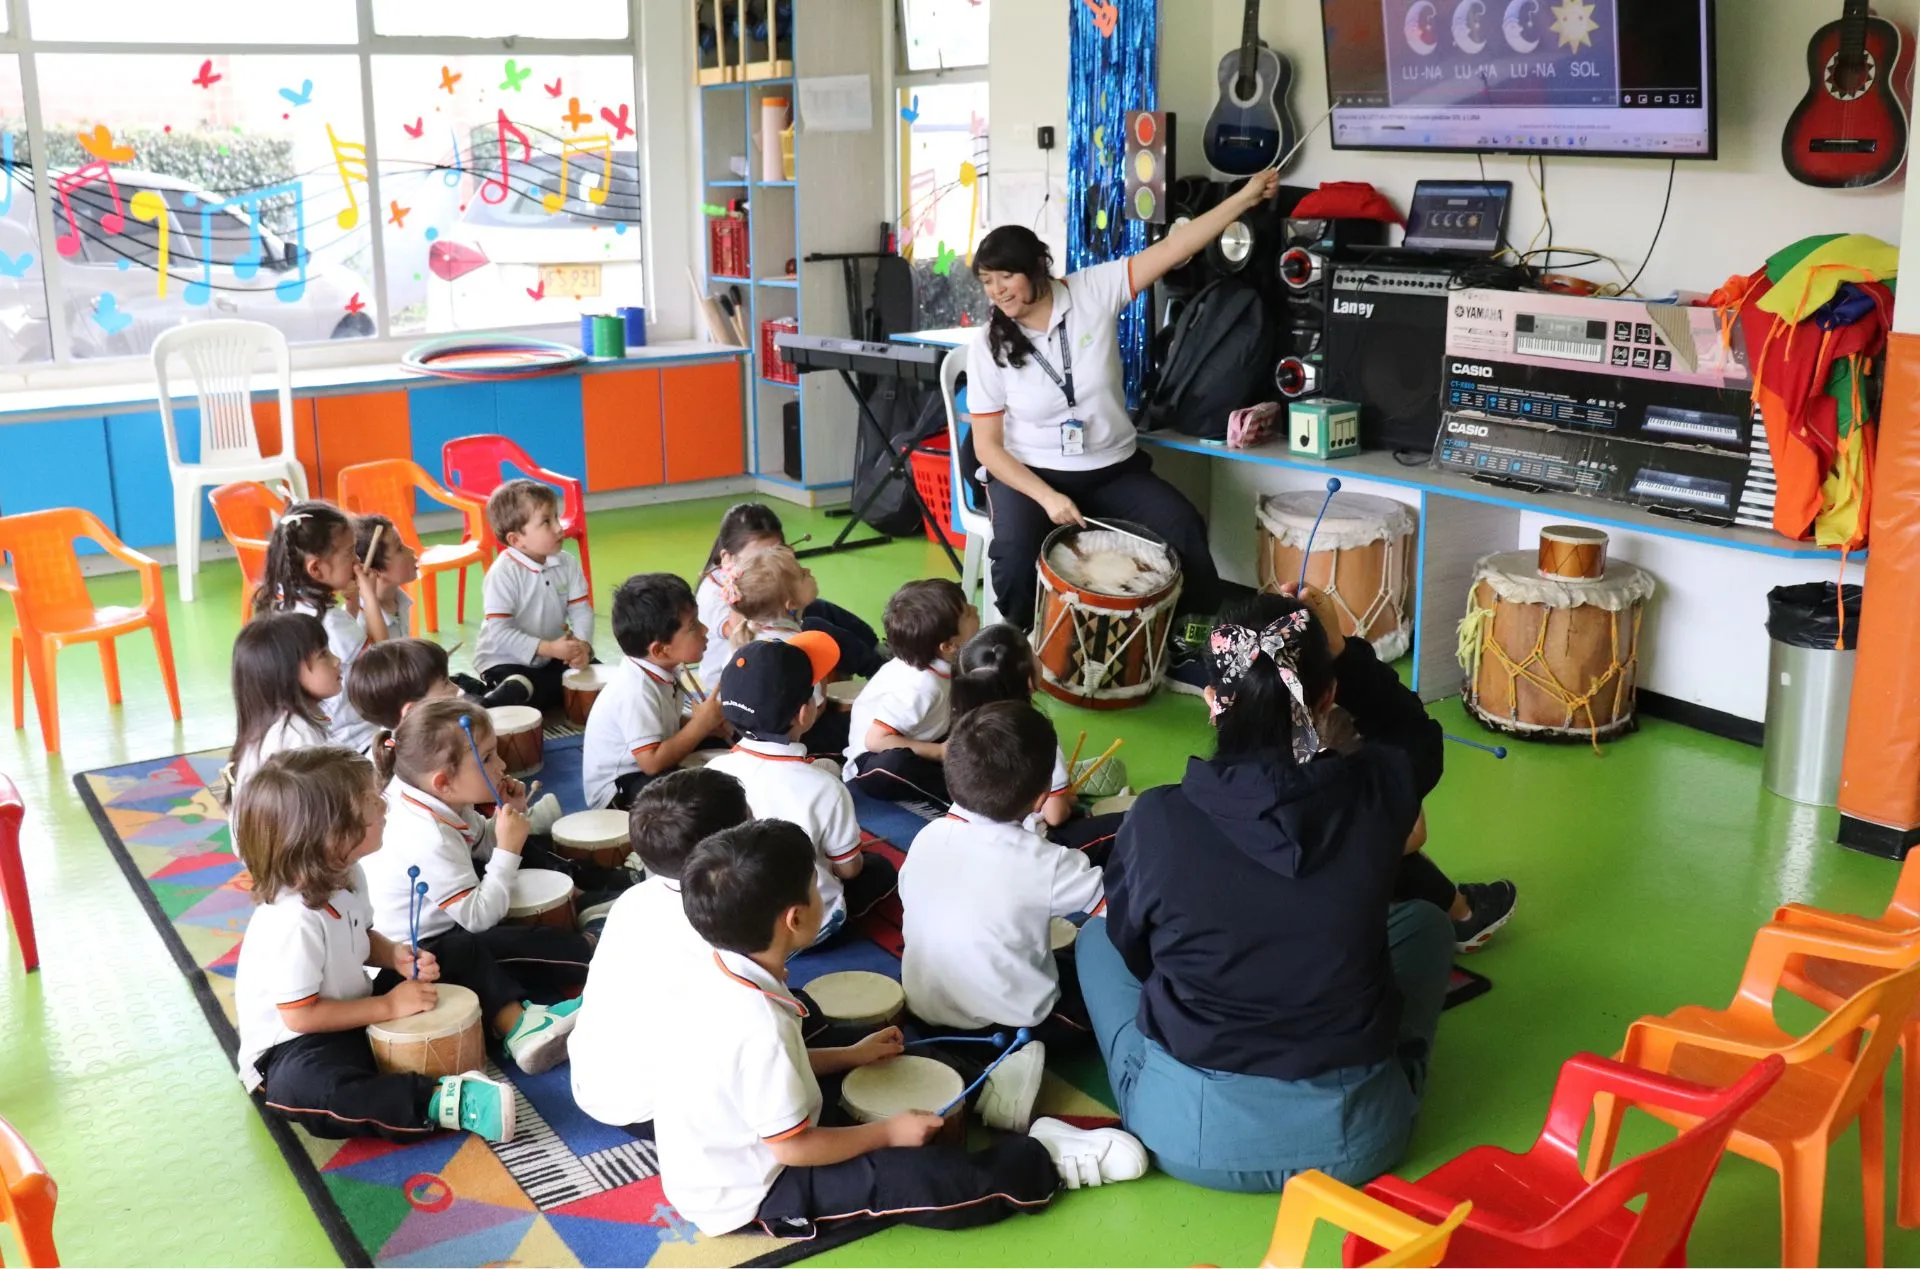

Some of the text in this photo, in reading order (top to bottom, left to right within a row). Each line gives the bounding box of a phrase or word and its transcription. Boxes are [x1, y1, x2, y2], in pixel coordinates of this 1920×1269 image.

[1402, 65, 1418, 80] LU
[1454, 64, 1471, 80] LU
[1510, 63, 1528, 78] LU
[1570, 61, 1600, 77] SOL
[1333, 297, 1375, 318] Laney
[1466, 306, 1502, 321] YAMAHA
[1451, 362, 1493, 378] CASIO
[1447, 421, 1489, 437] CASIO
